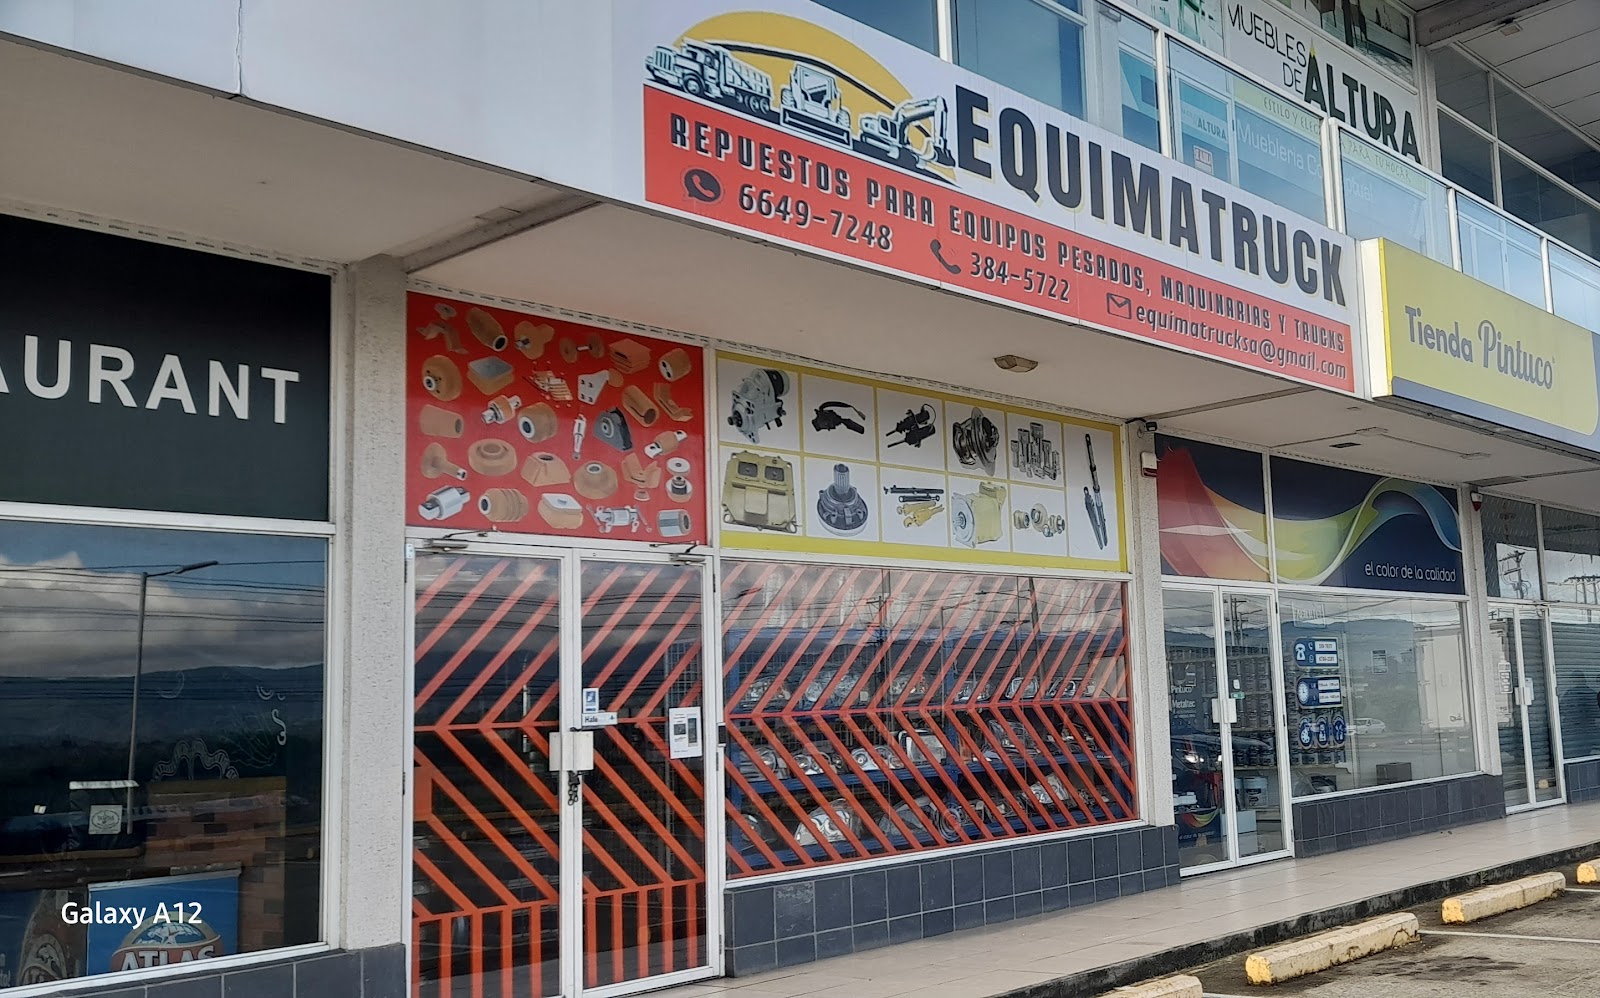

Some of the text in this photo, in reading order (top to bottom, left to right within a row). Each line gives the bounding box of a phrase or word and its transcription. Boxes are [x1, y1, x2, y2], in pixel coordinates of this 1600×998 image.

[1227, 4, 1307, 68] MUEBLES
[1197, 117, 1227, 141] ALTURA
[1263, 96, 1291, 120] ESTILO
[1292, 111, 1299, 125] Y
[1348, 139, 1372, 162] PARA
[1282, 40, 1423, 165] DE ALTURA
[670, 112, 1346, 353] REPUESTOS PARA EQUIPOS PESADOS, MAQUINARIAS Y TRUCKS
[954, 84, 1347, 307] EQUIMATRUCK
[738, 183, 1348, 381] 6649-7248 384-5722 equimatrucksa@gmail.com
[0, 333, 301, 424] URANT
[1404, 304, 1555, 390] Tienda Pintuco
[1364, 560, 1457, 583] el color de la calidad
[584, 715, 599, 725] Hale
